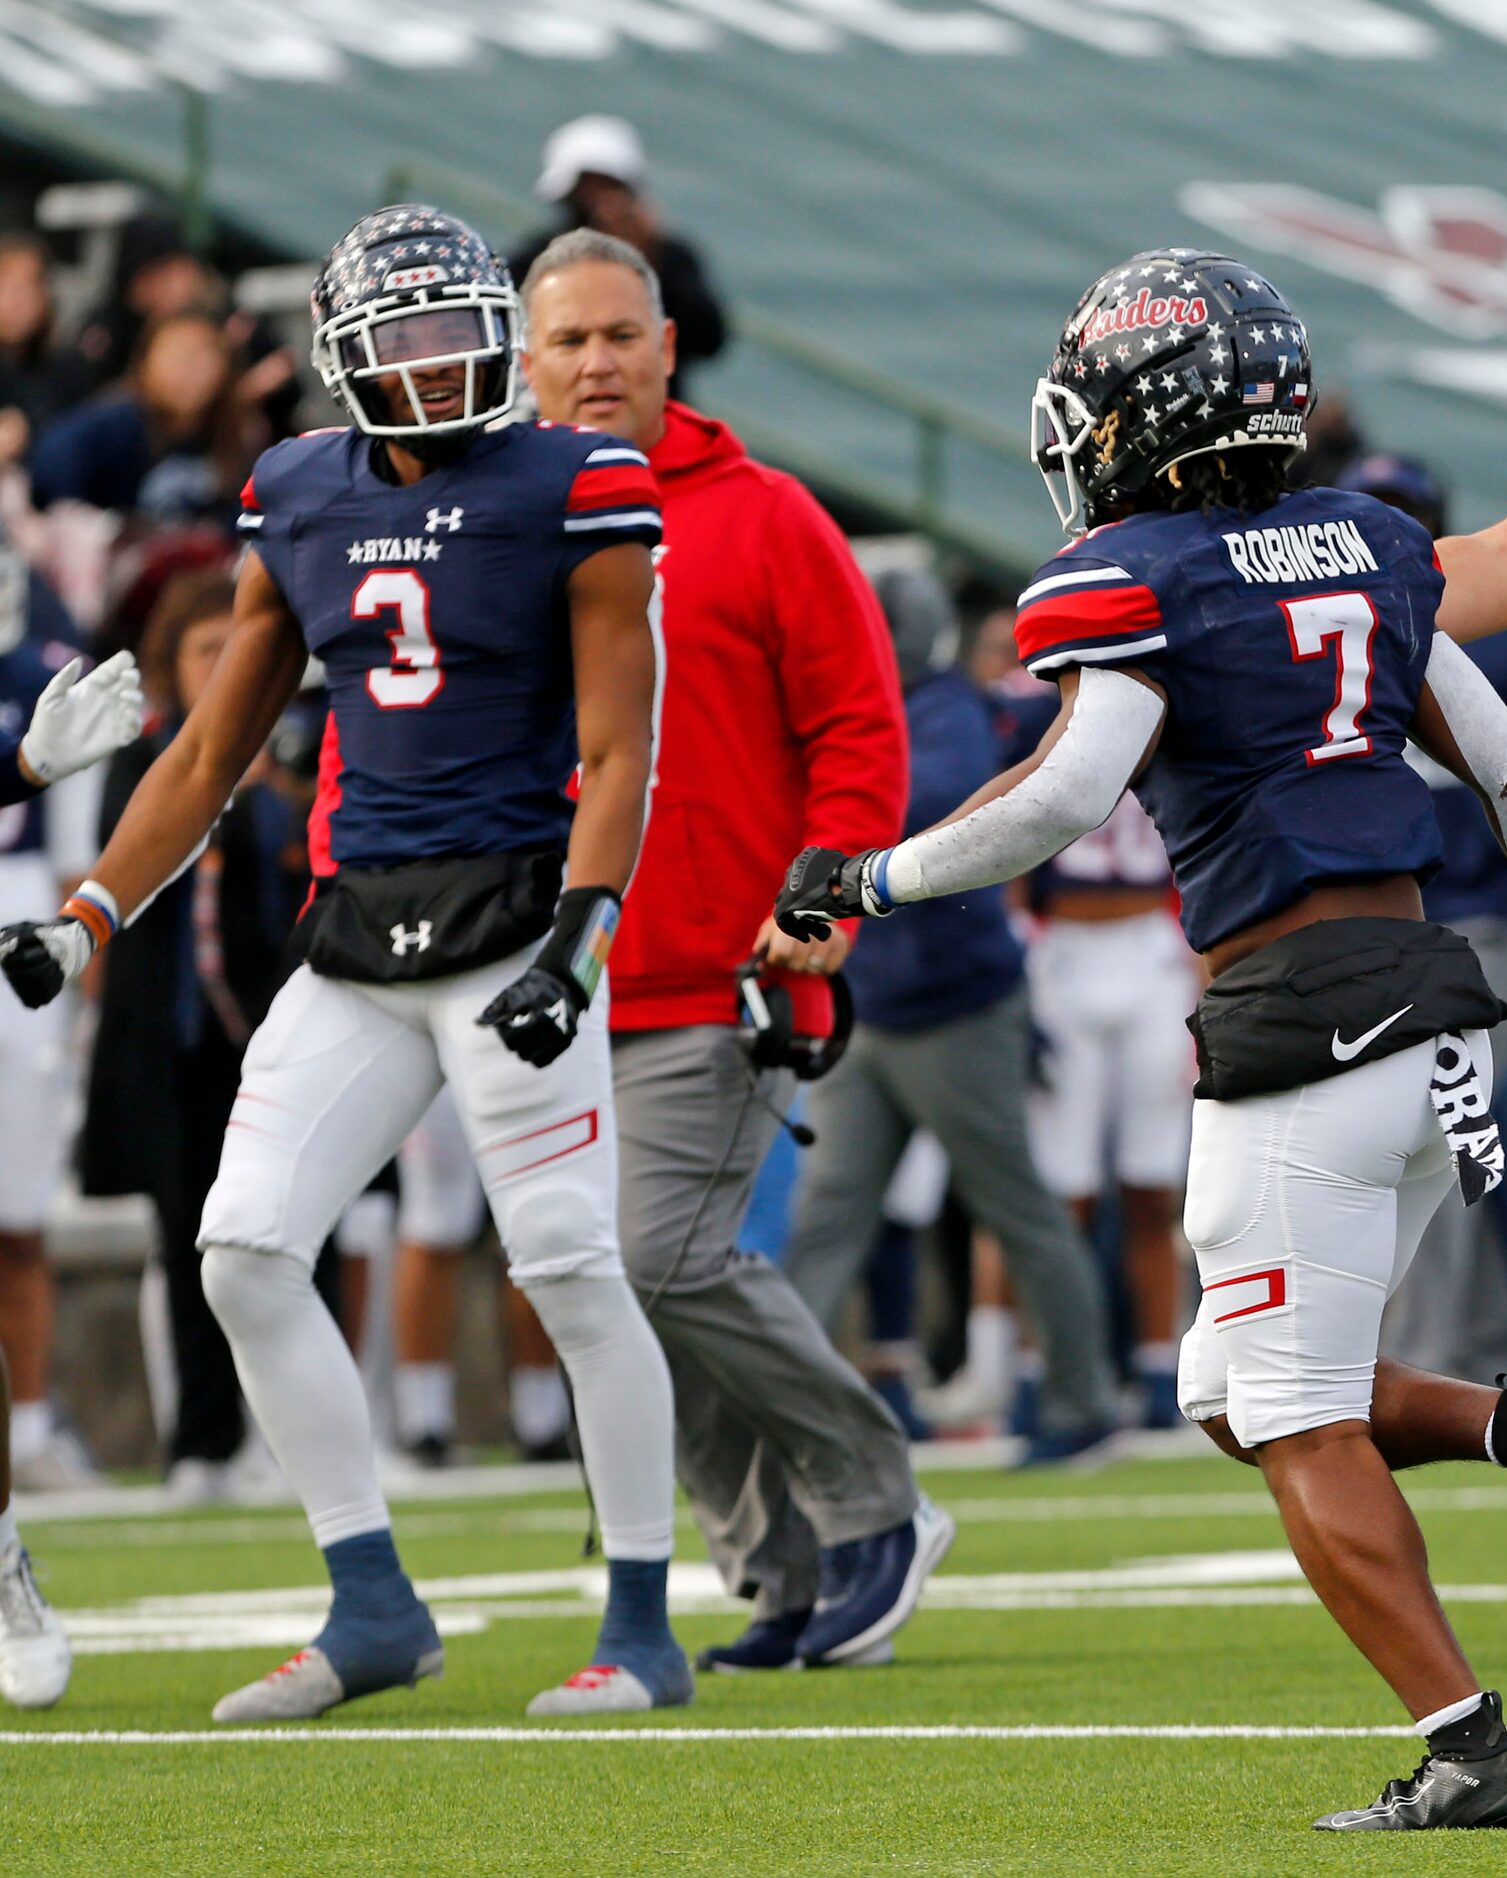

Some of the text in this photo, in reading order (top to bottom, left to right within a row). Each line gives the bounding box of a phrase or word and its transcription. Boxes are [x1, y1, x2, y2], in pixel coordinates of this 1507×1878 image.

[1277, 355, 1288, 378] 7
[363, 538, 423, 563] RYAN
[1221, 519, 1380, 583] ROBINSON
[351, 567, 446, 710] 3
[1275, 590, 1381, 768] 7
[1451, 1771, 1480, 1788] VAPOR
